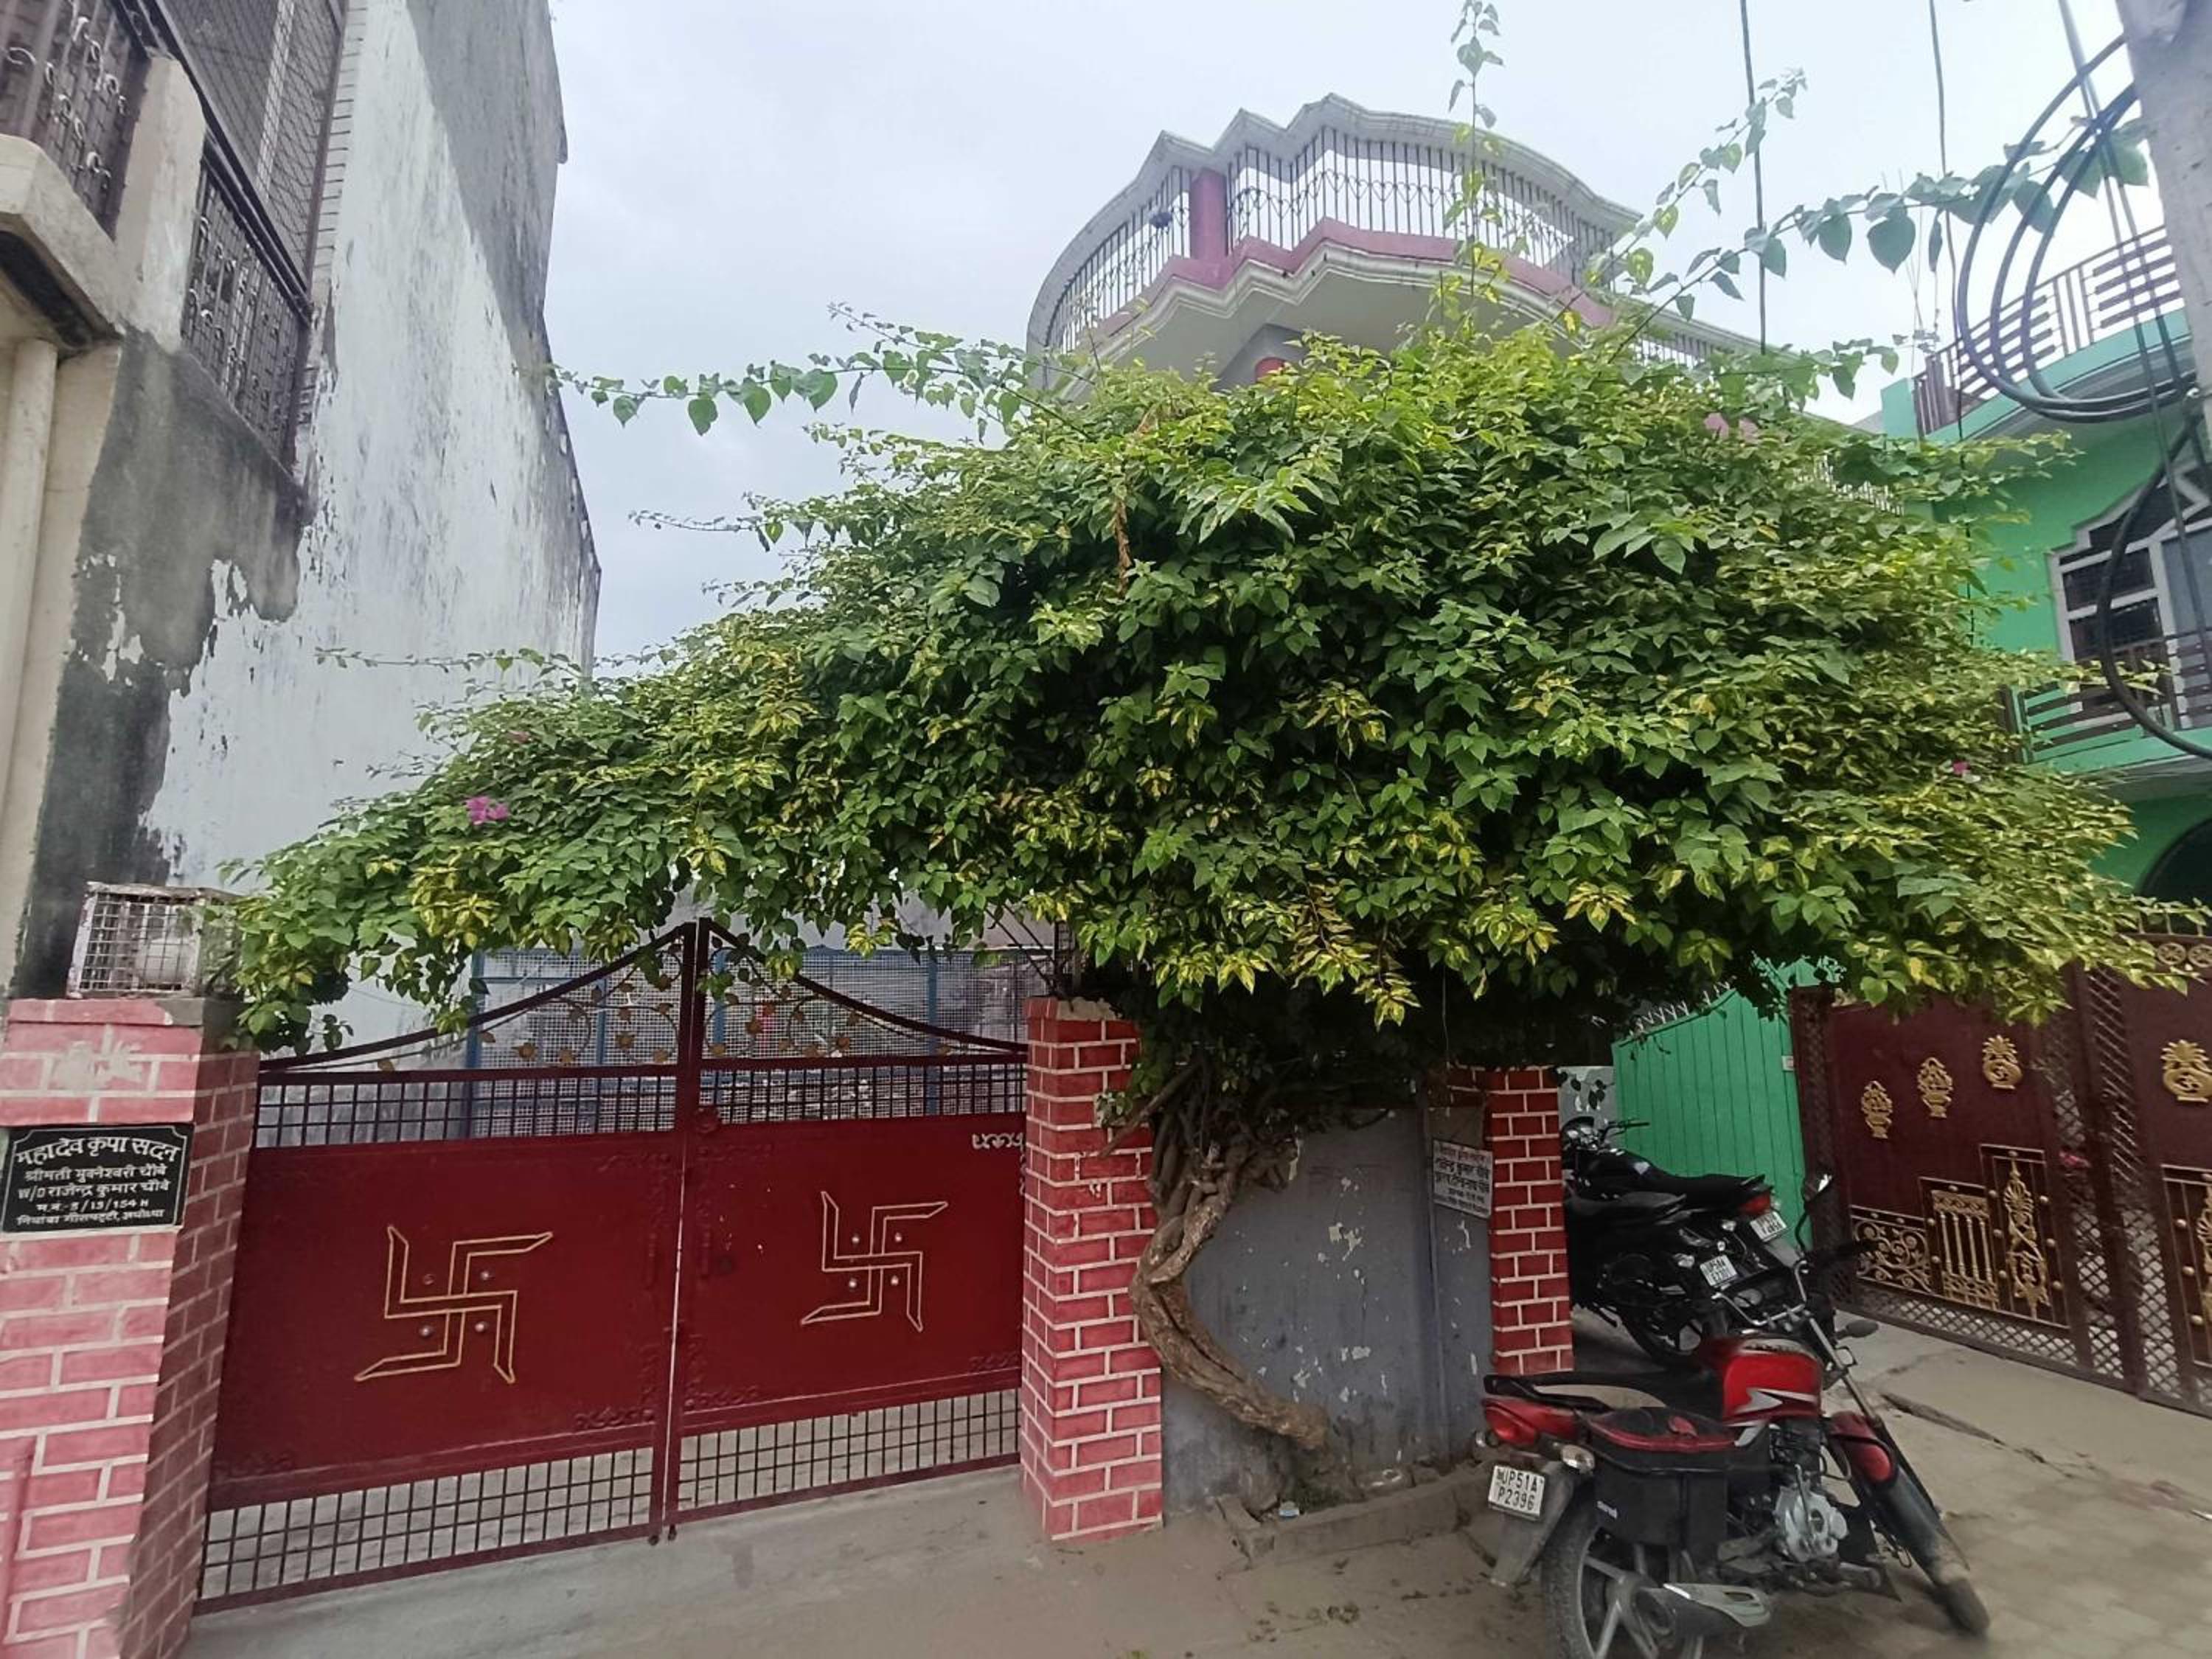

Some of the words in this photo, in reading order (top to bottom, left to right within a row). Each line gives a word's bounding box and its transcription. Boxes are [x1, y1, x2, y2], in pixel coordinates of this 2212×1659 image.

[15, 1138, 83, 1164] महादेव
[87, 1137, 127, 1156] कृपा
[132, 1138, 181, 1161] सदन
[95, 1183, 138, 1198] कुमार
[1501, 1470, 1538, 1493] UP51A
